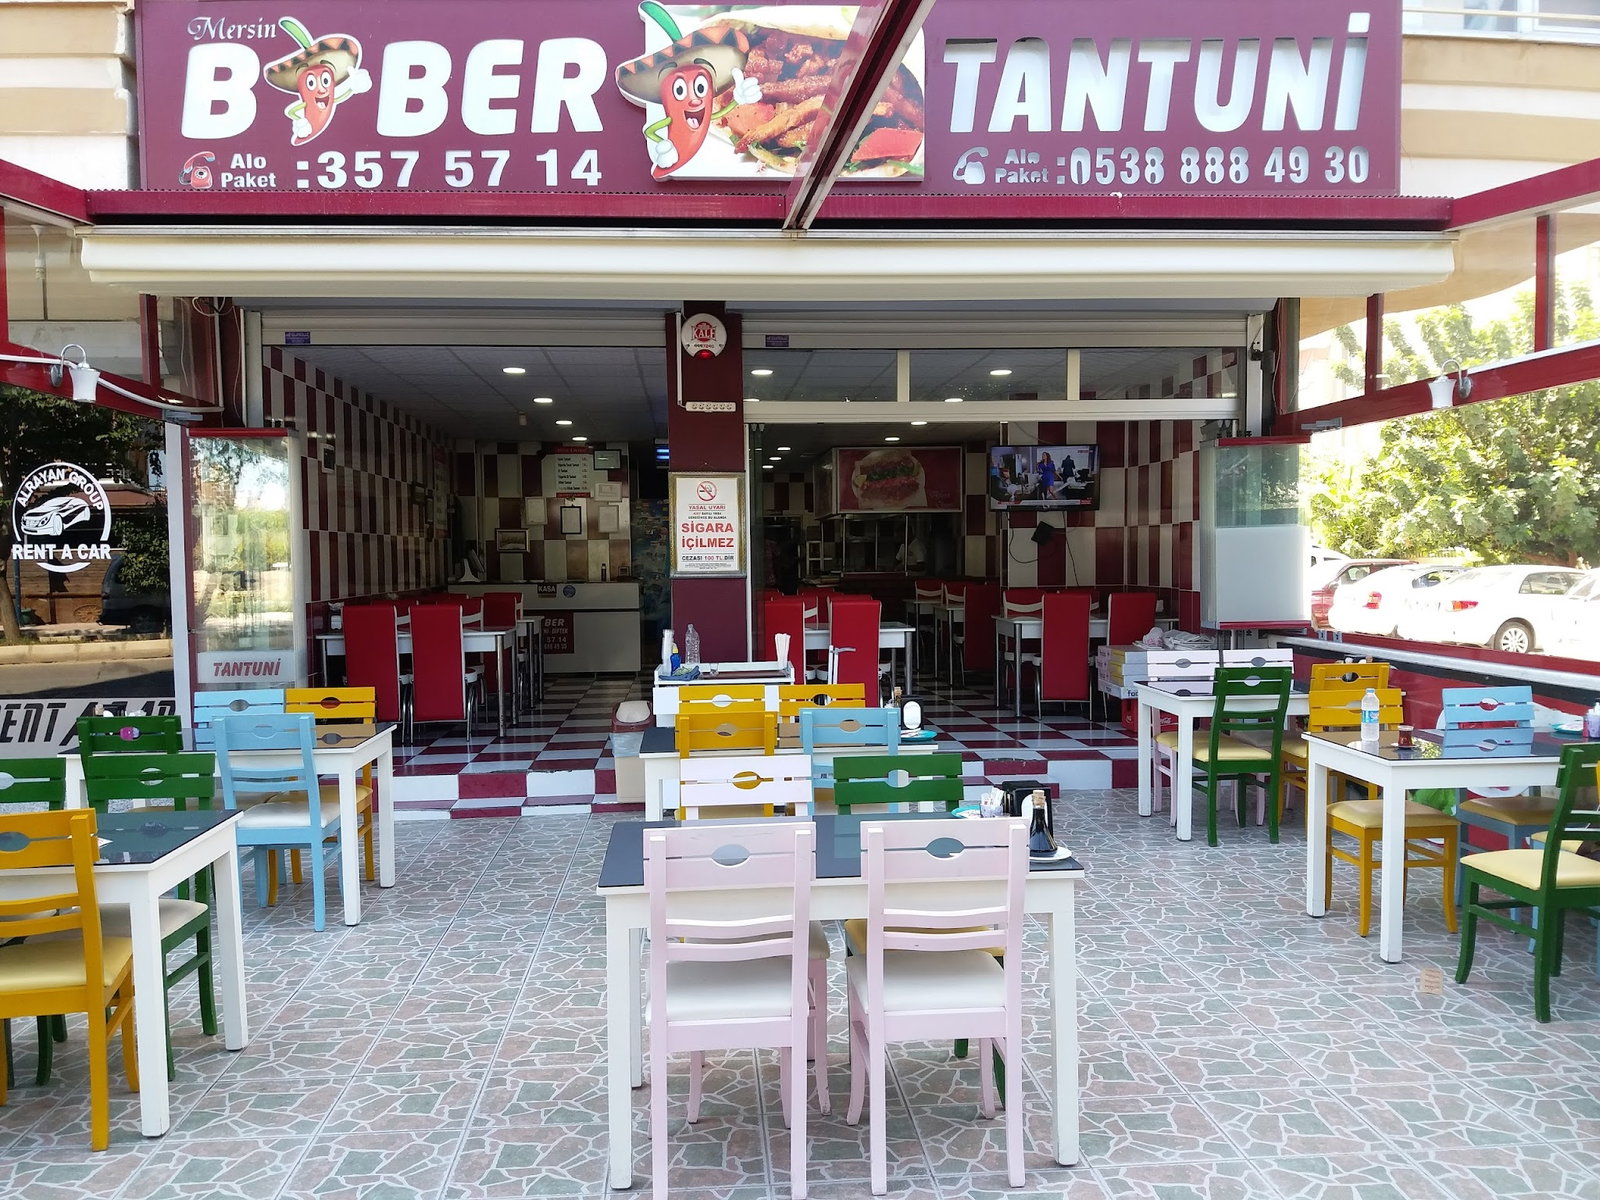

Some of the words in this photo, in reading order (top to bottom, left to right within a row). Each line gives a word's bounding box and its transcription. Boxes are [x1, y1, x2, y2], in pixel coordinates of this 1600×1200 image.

[187, 16, 277, 41] Mersin
[943, 12, 1371, 133] TANTUNİ
[230, 153, 267, 169] Alo
[995, 167, 1049, 183] Paket
[1180, 146, 1250, 184] 888
[1264, 145, 1310, 183] 49
[1324, 145, 1369, 183] 30
[1004, 148, 1040, 165] Alo
[220, 172, 277, 188] Paket
[444, 149, 511, 188] 57
[536, 149, 602, 187] 14
[16, 468, 67, 508] ALRAYAN
[68, 471, 104, 511] GROUP
[681, 520, 734, 533] SİGARA
[12, 544, 57, 560] RENT
[61, 544, 73, 560] A
[77, 543, 112, 560] CAR
[681, 535, 734, 550] İÇİLMEZ
[213, 658, 281, 677] TANTUNİ
[0, 702, 67, 743] ENT
